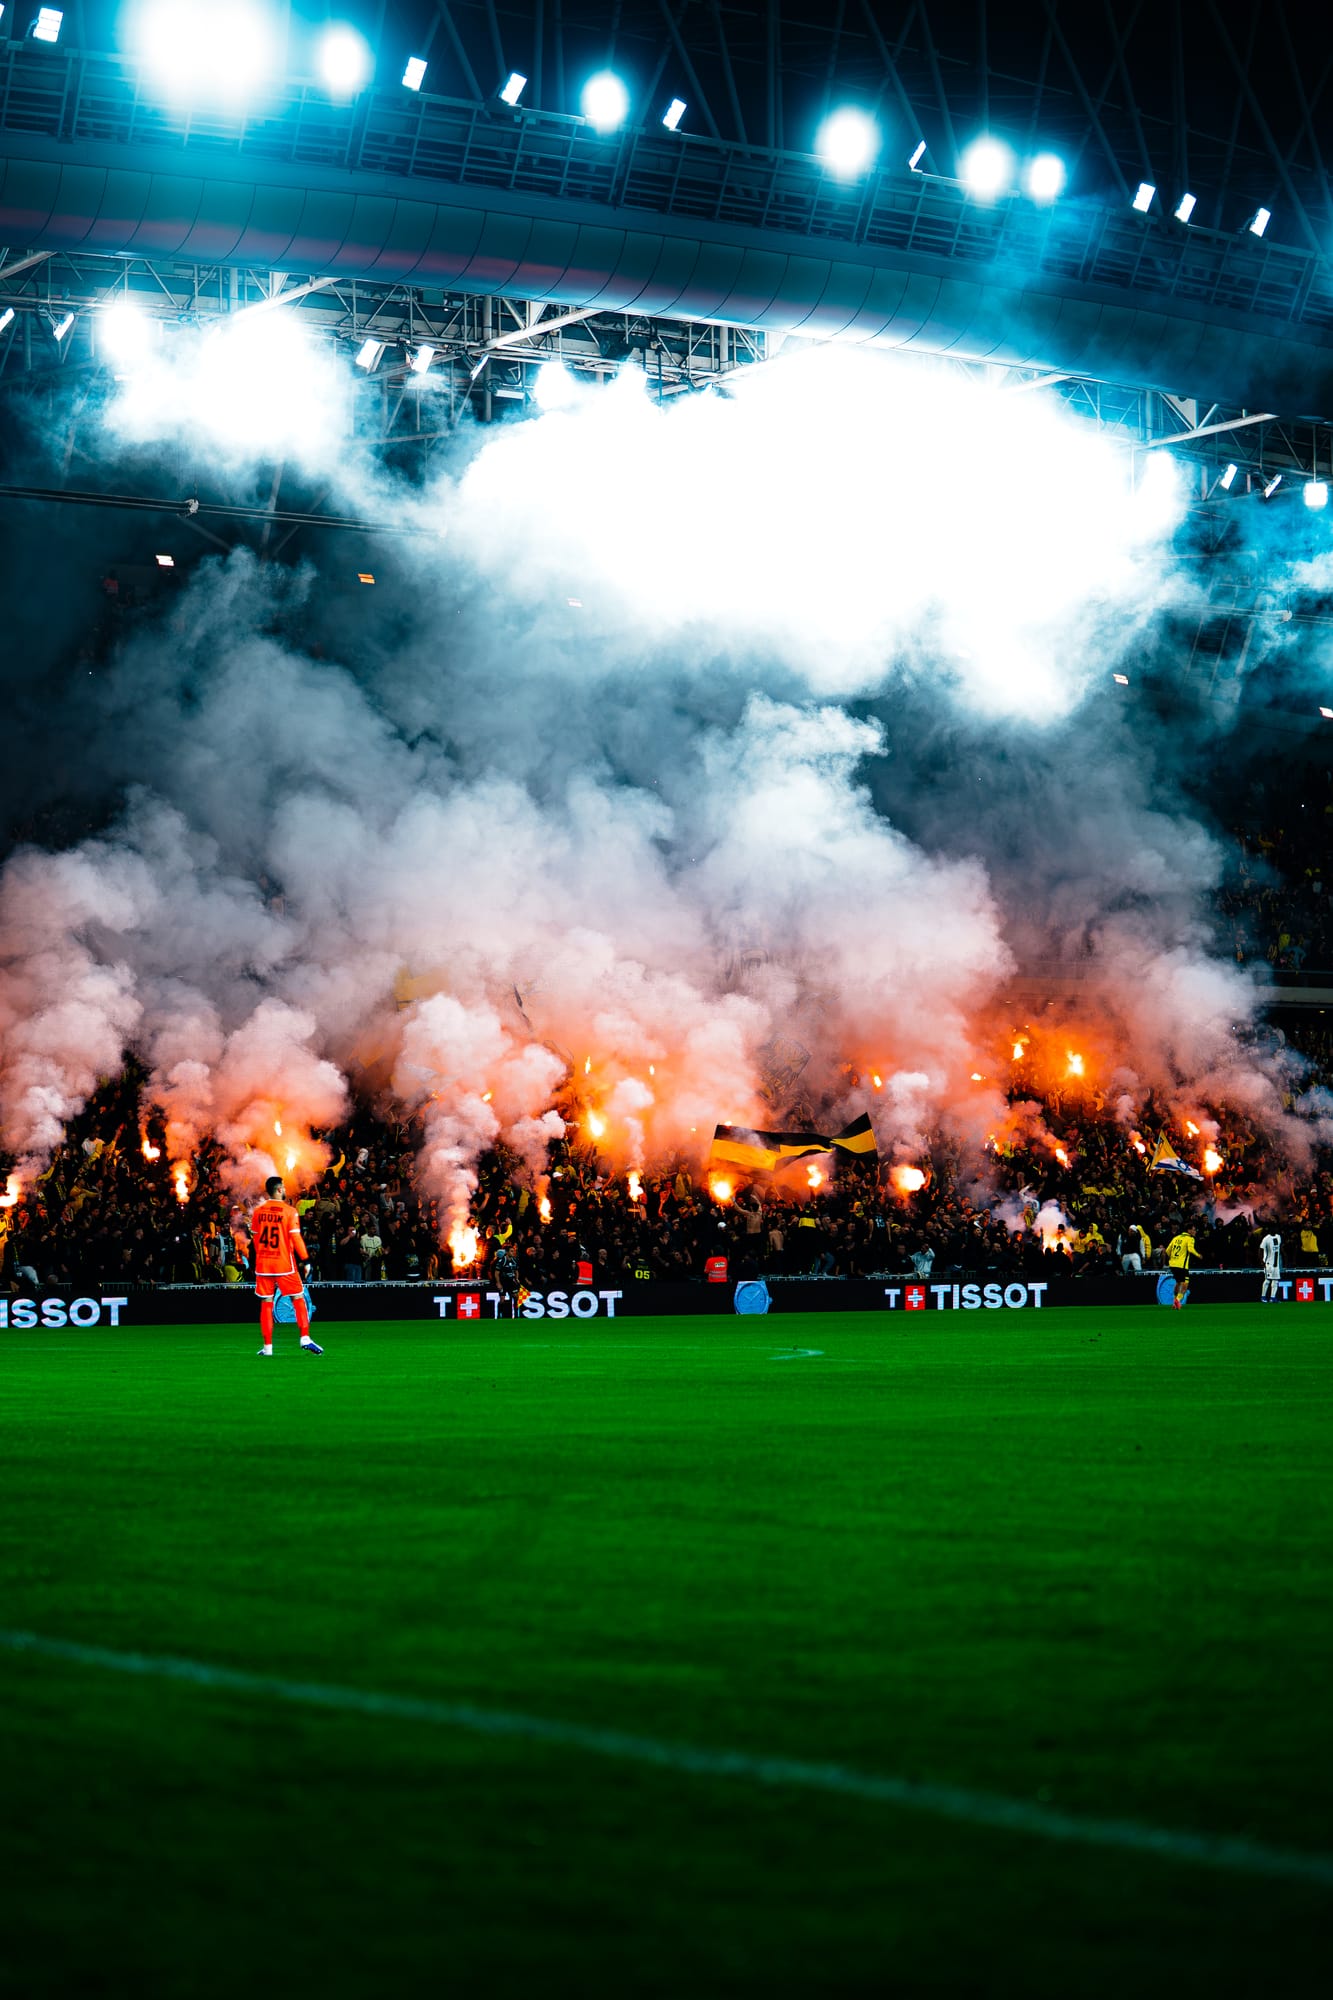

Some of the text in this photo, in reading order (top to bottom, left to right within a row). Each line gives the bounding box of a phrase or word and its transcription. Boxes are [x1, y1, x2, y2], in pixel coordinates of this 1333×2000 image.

[259, 1225, 280, 1249] 45
[635, 1270, 651, 1280] 05
[486, 1290, 623, 1319] TSSOT
[930, 1282, 1048, 1310] TISSOT
